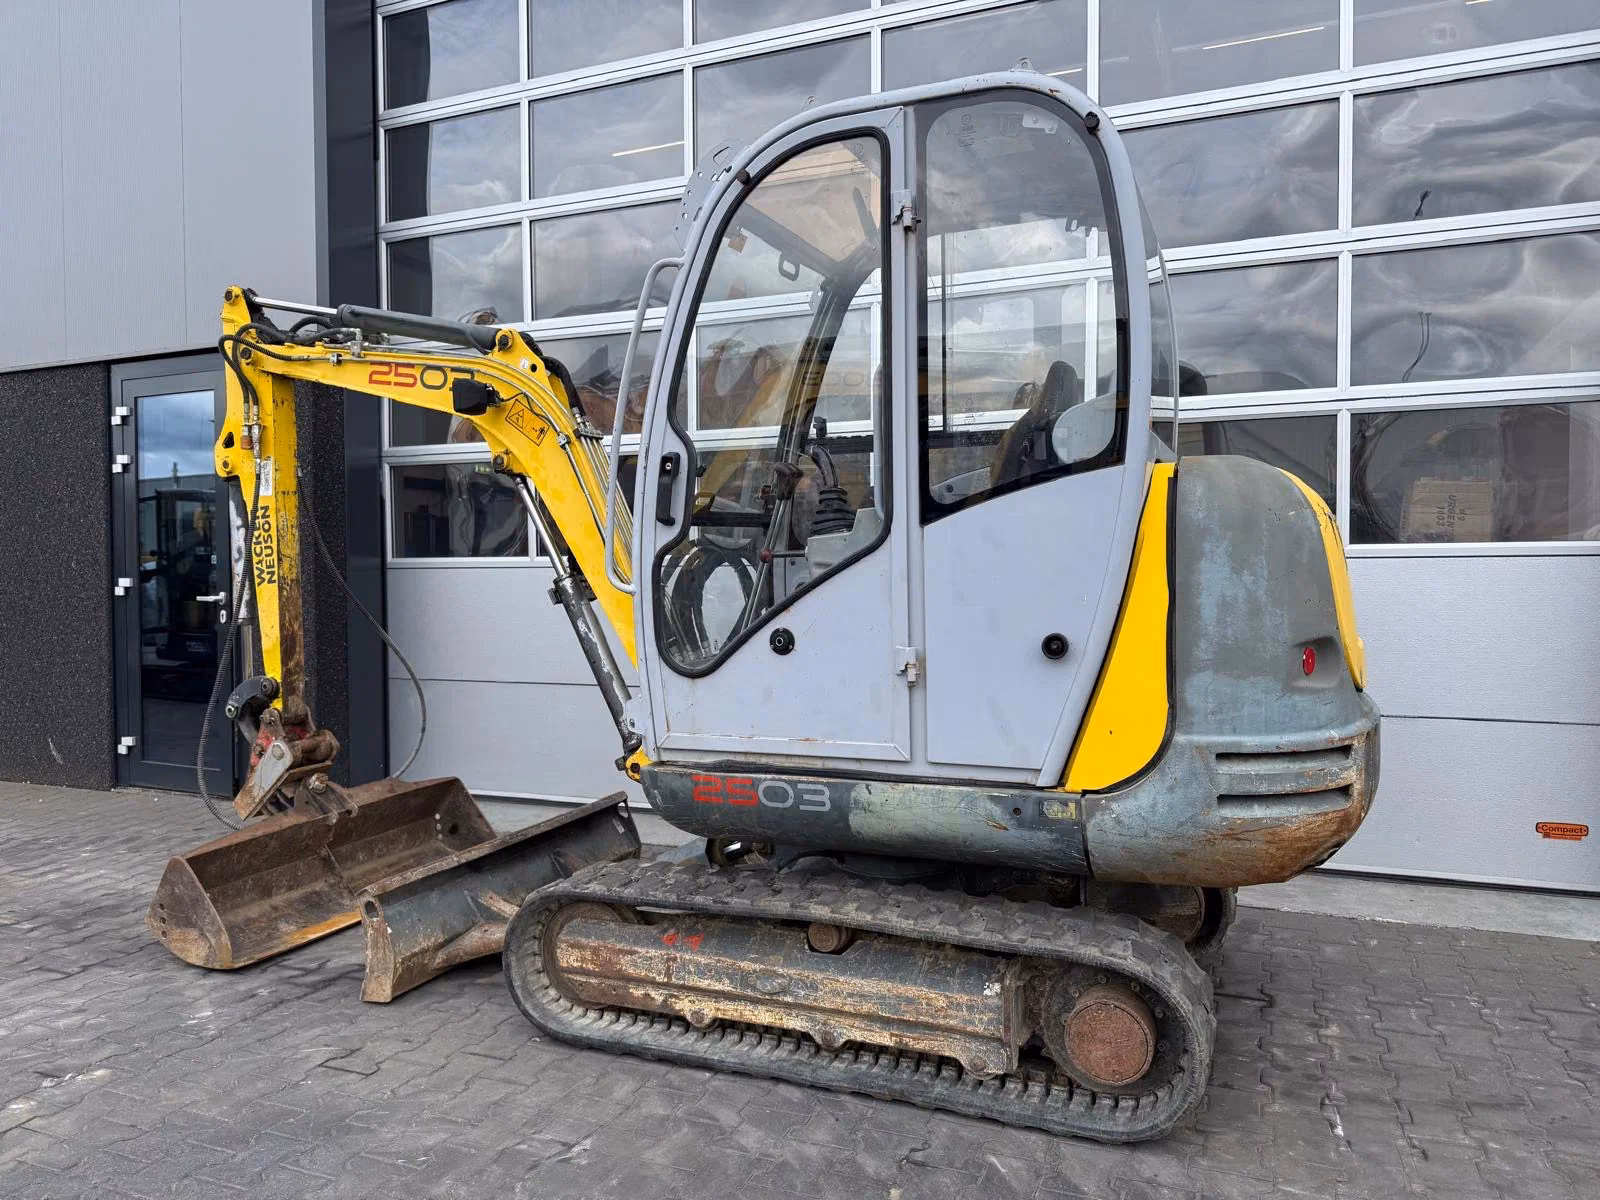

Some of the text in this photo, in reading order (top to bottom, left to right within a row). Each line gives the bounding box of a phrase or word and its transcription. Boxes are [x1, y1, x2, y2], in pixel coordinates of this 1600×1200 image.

[260, 504, 277, 585] NEUSON
[691, 774, 832, 812] 2503
[1541, 824, 1585, 834] Compact
